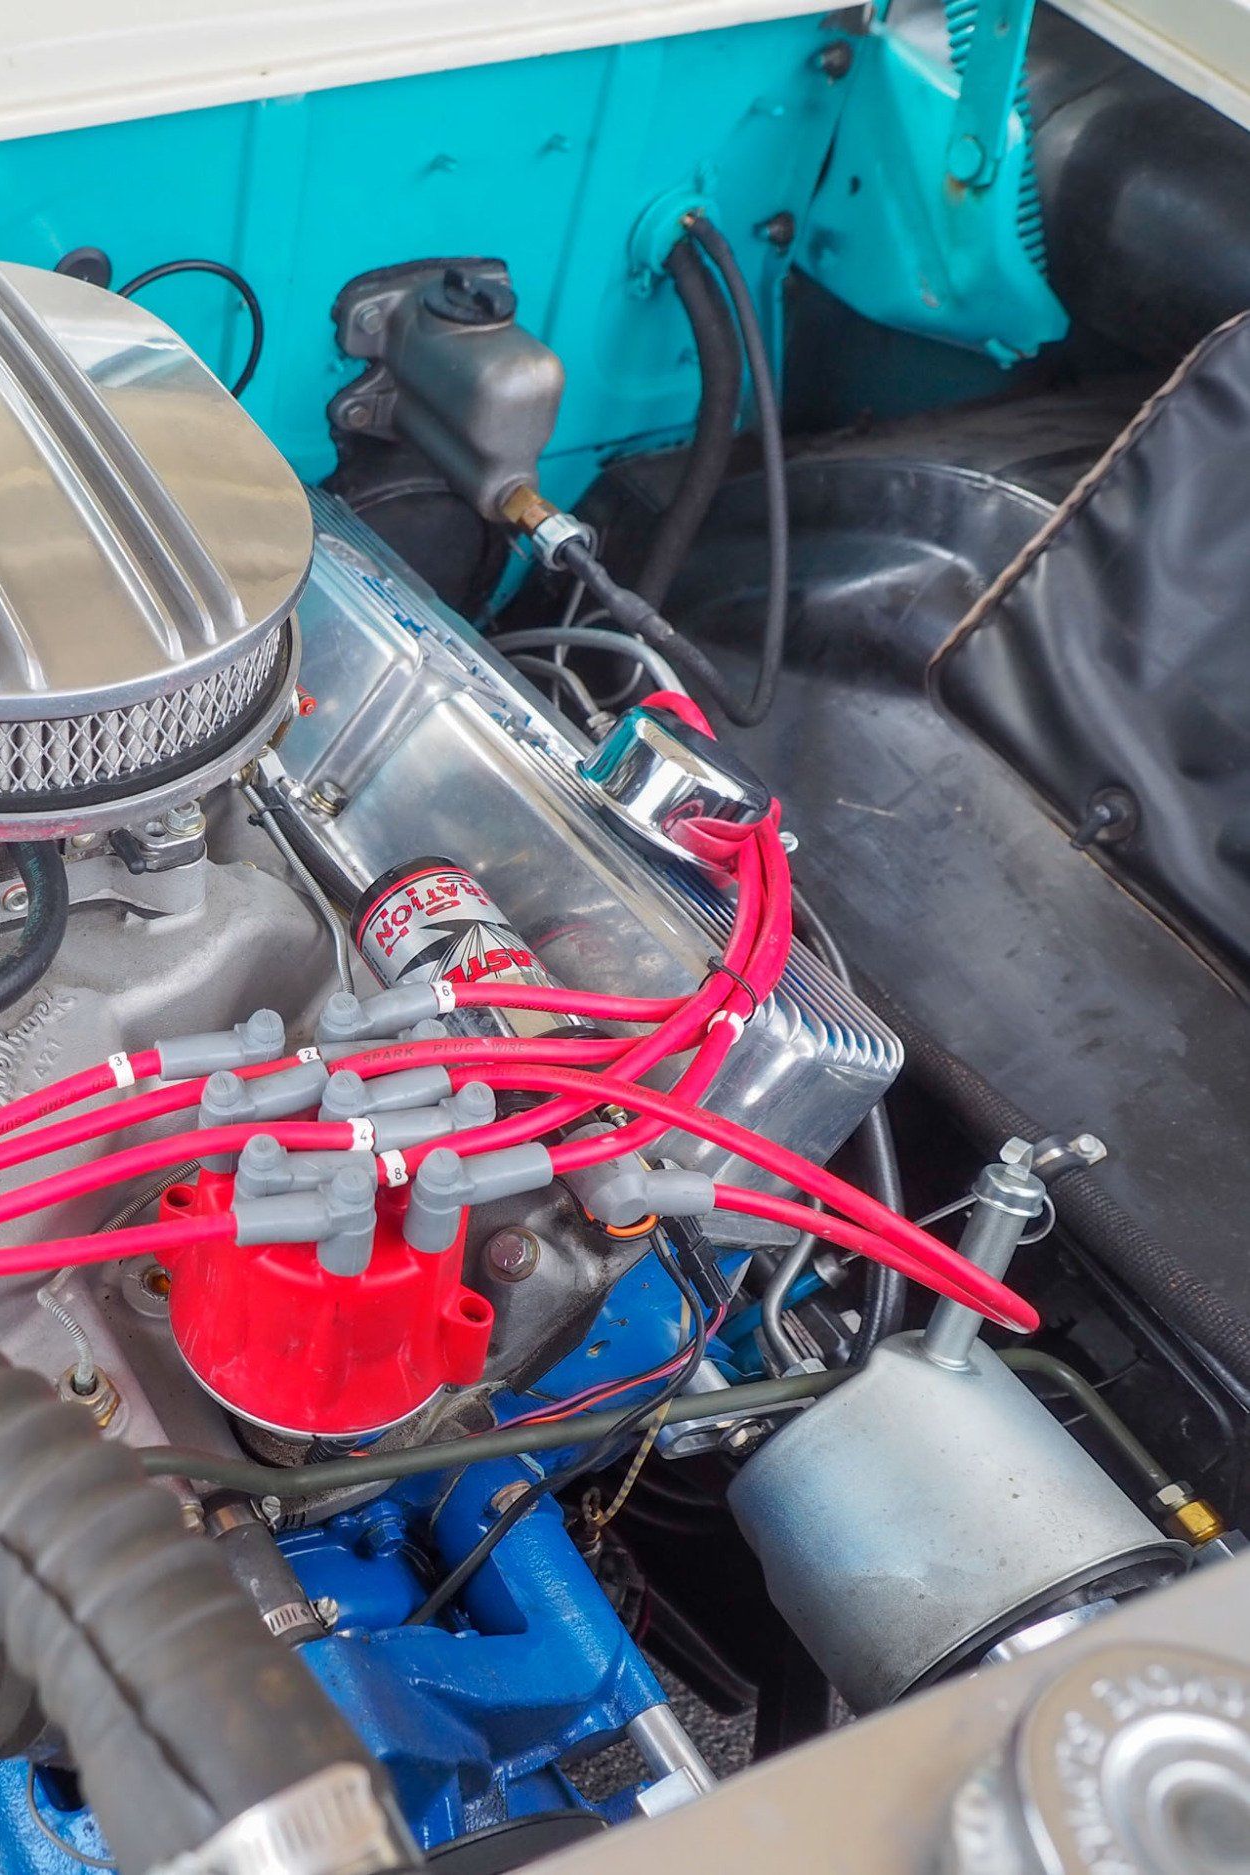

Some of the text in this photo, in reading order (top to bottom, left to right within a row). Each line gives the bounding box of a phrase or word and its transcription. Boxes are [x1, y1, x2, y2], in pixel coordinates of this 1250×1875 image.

[441, 984, 450, 998] 6
[305, 1048, 313, 1060] 2
[362, 1046, 414, 1065] SPARK
[433, 1042, 474, 1055] PLUG
[114, 1056, 123, 1067] 3
[359, 1129, 368, 1143] 4
[393, 1167, 403, 1180] 8
